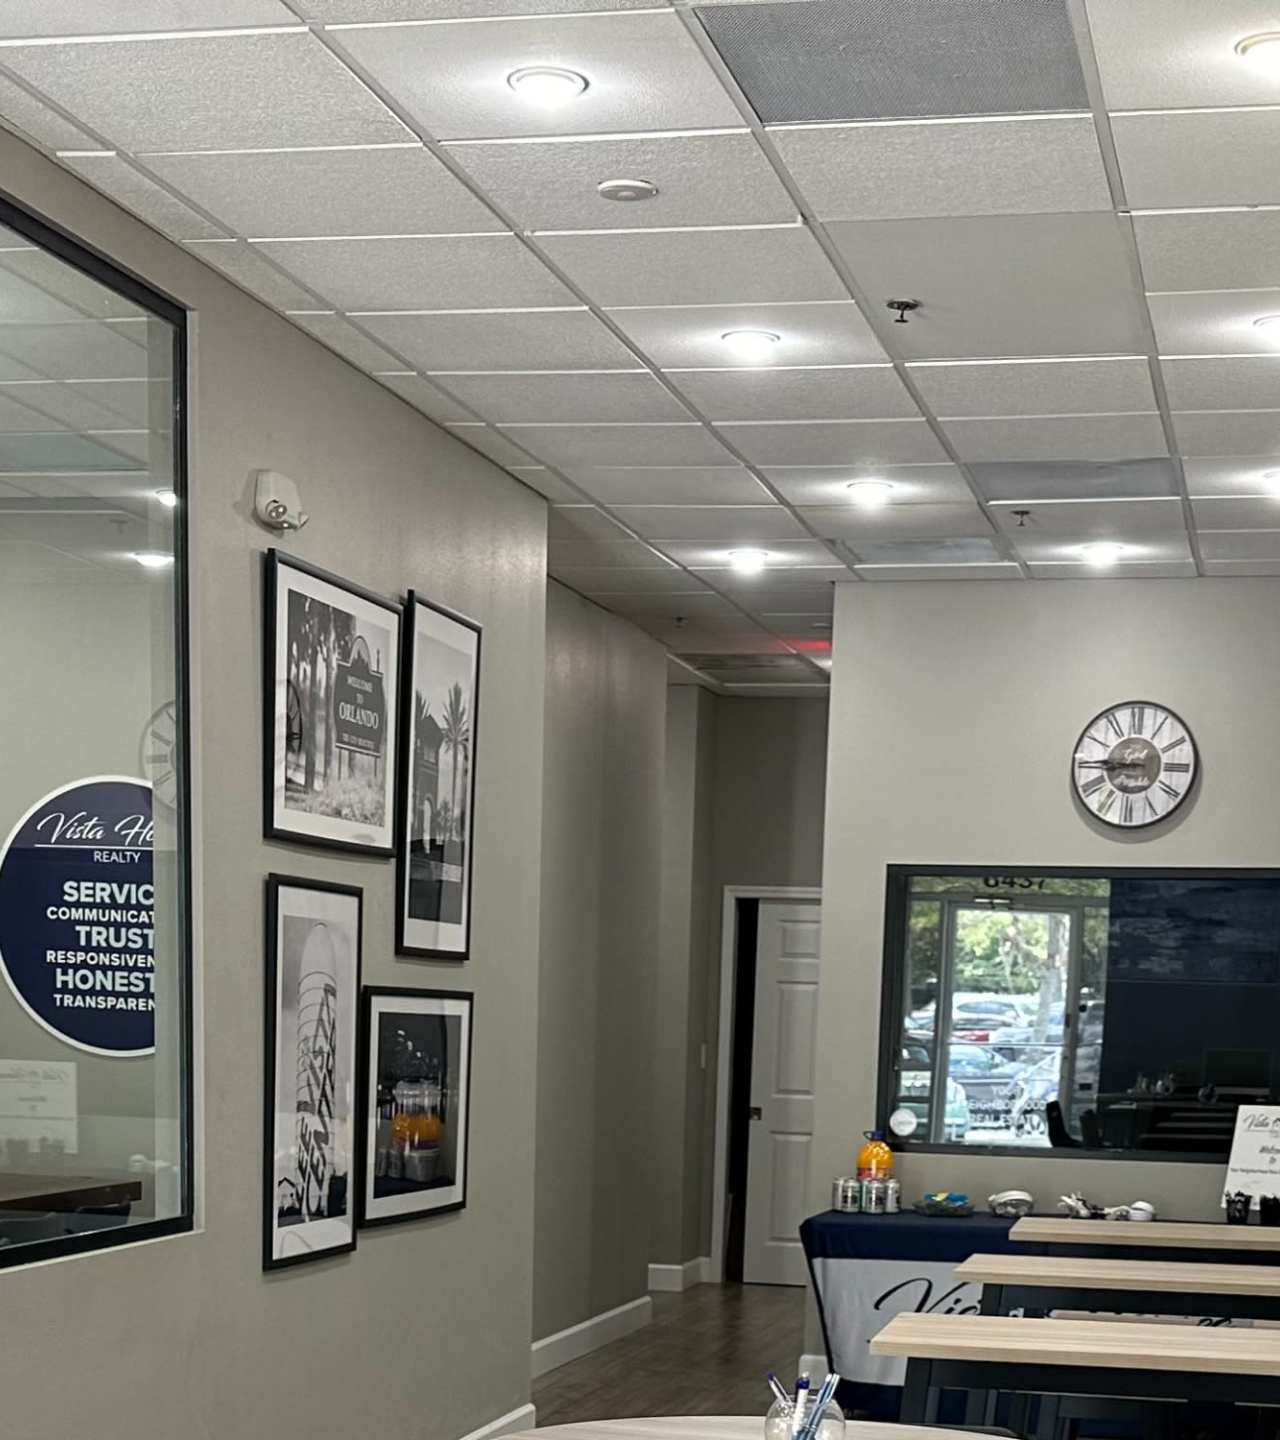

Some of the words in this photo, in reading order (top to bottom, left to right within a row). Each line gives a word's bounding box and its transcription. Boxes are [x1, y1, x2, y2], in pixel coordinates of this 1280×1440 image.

[37, 811, 107, 844] Vista
[93, 850, 141, 863] REALTY
[63, 880, 154, 905] SERVIC
[75, 924, 154, 949] TRUST
[55, 967, 154, 993] HONEST
